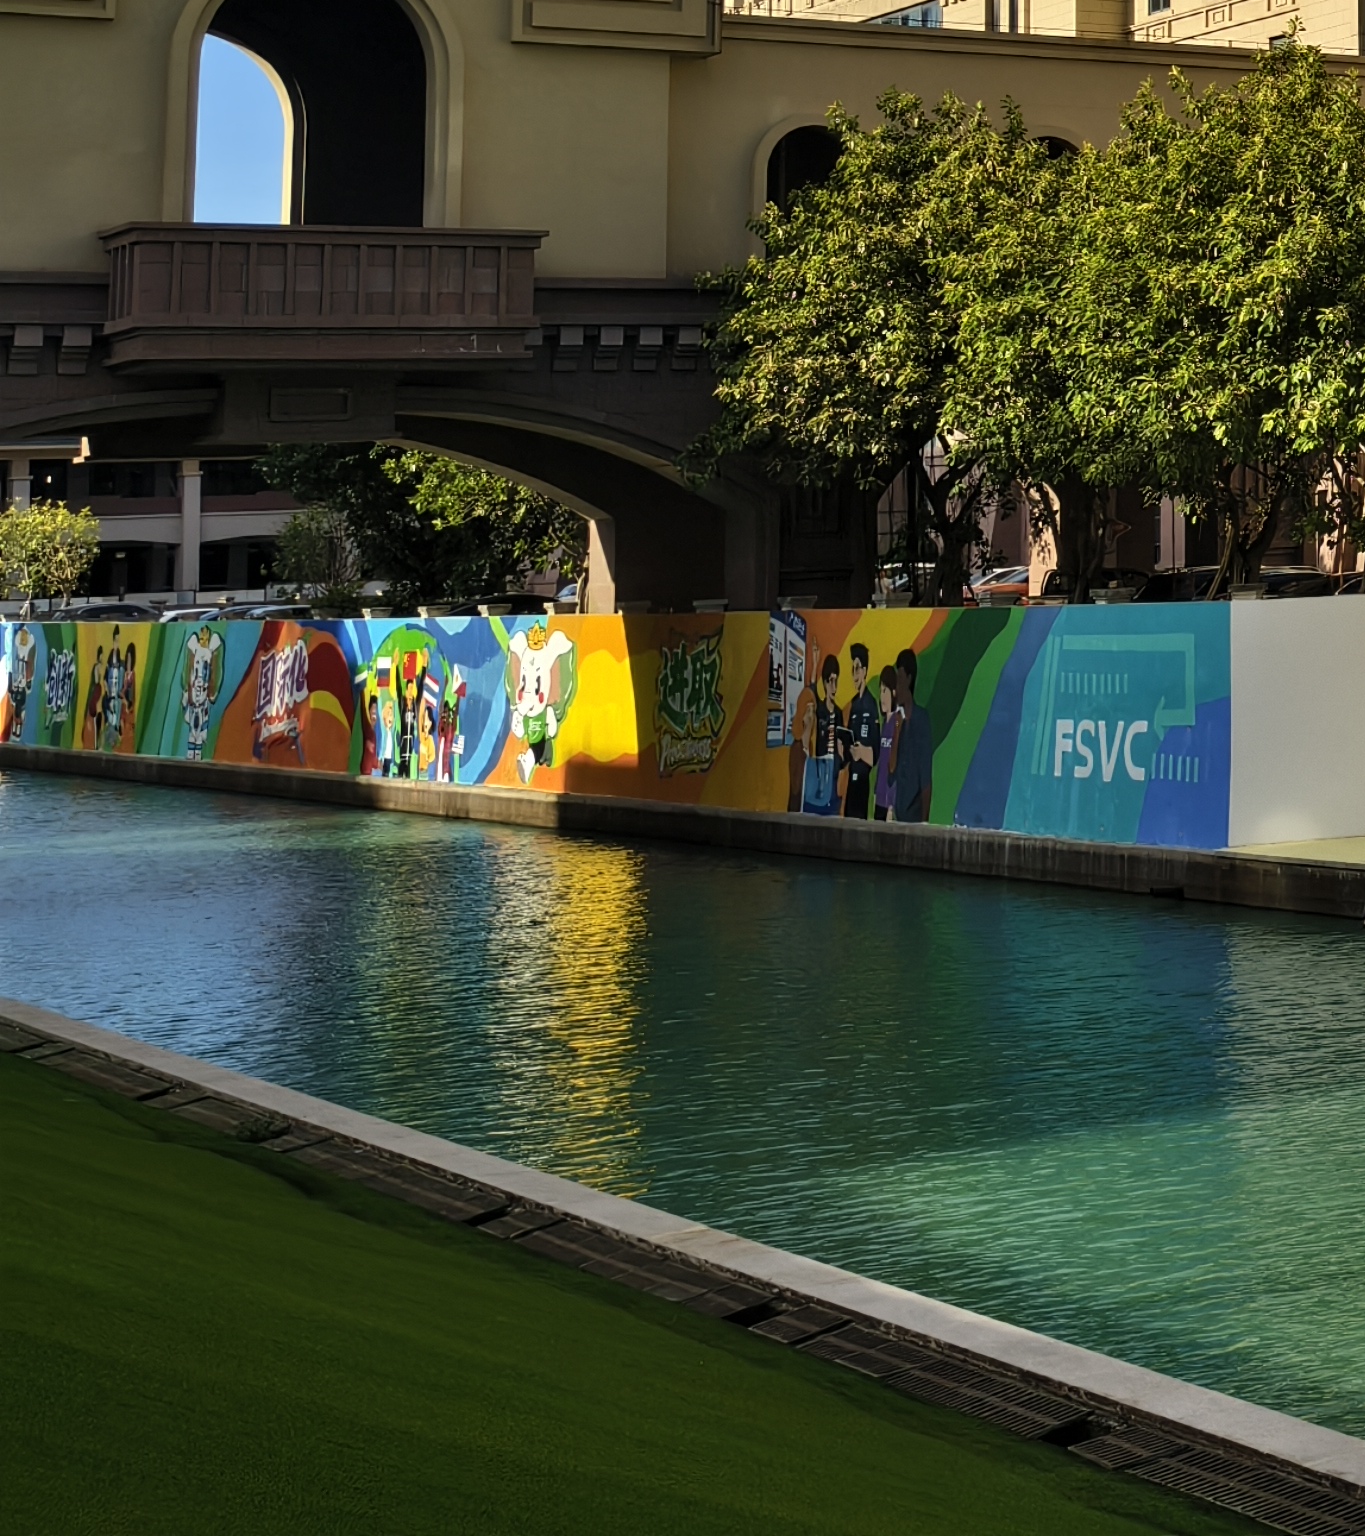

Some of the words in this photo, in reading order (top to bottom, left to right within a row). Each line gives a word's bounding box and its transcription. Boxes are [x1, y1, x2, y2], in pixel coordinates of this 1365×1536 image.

[256, 638, 309, 718] 国际化
[658, 640, 726, 736] 进取
[1053, 718, 1149, 783] FSVC
